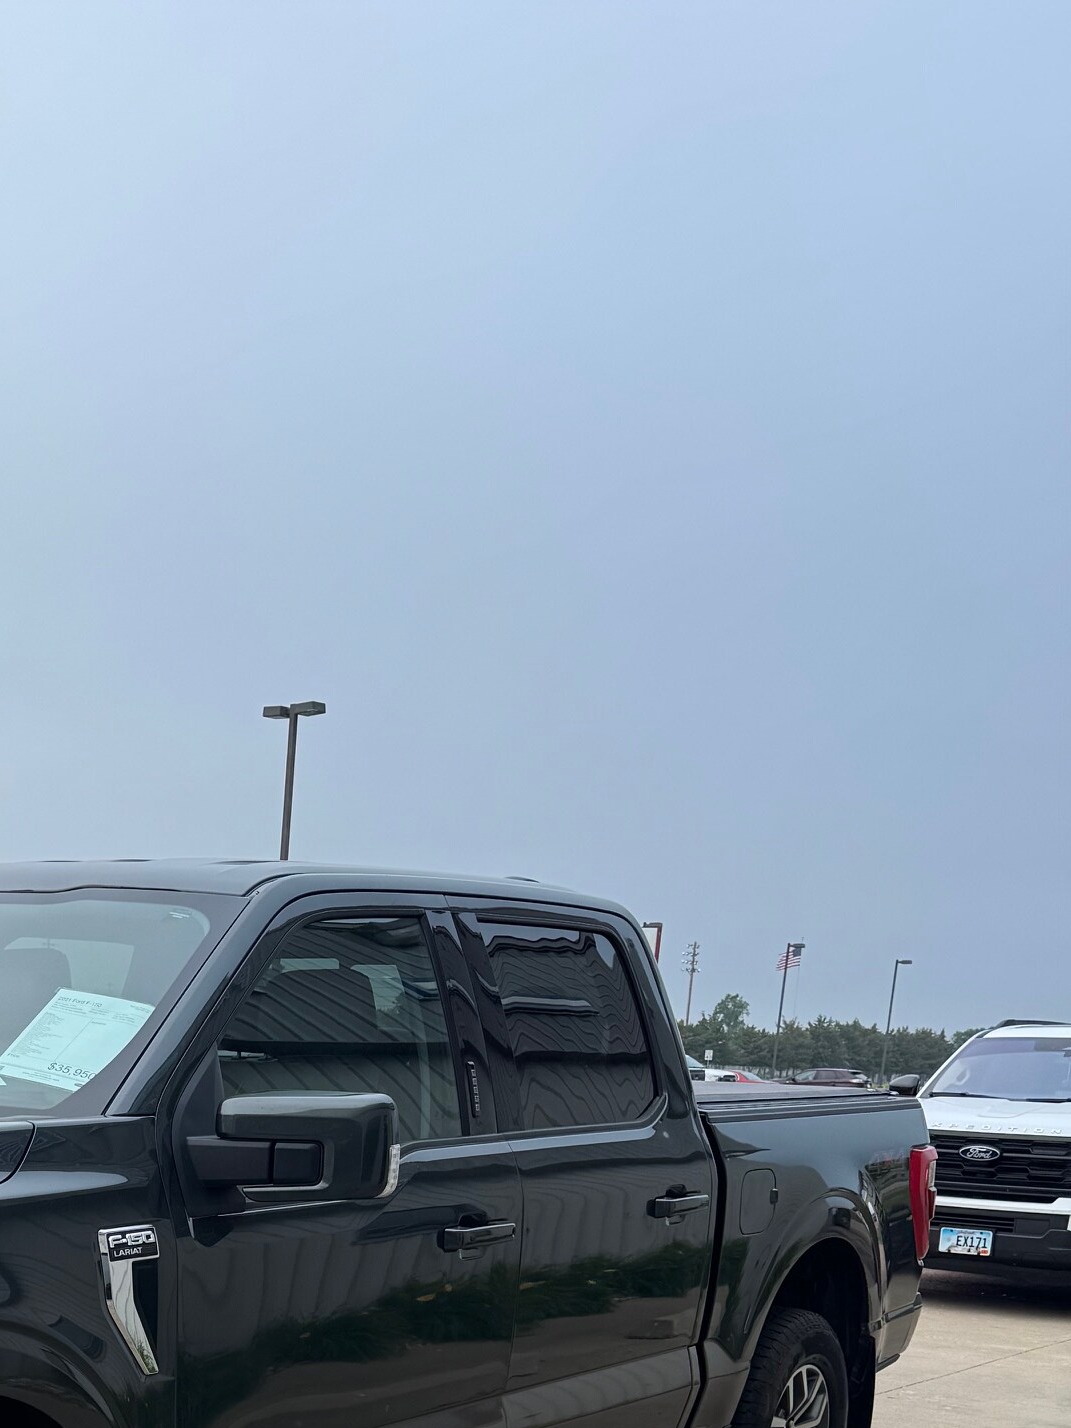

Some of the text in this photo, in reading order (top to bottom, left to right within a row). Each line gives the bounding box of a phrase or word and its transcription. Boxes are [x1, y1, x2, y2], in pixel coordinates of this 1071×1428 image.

[931, 1122, 1063, 1135] XPEDITION
[966, 1147, 993, 1159] Ford
[109, 1230, 156, 1248] F-150
[955, 1235, 988, 1250] EX171
[113, 1246, 143, 1257] LARIAT
